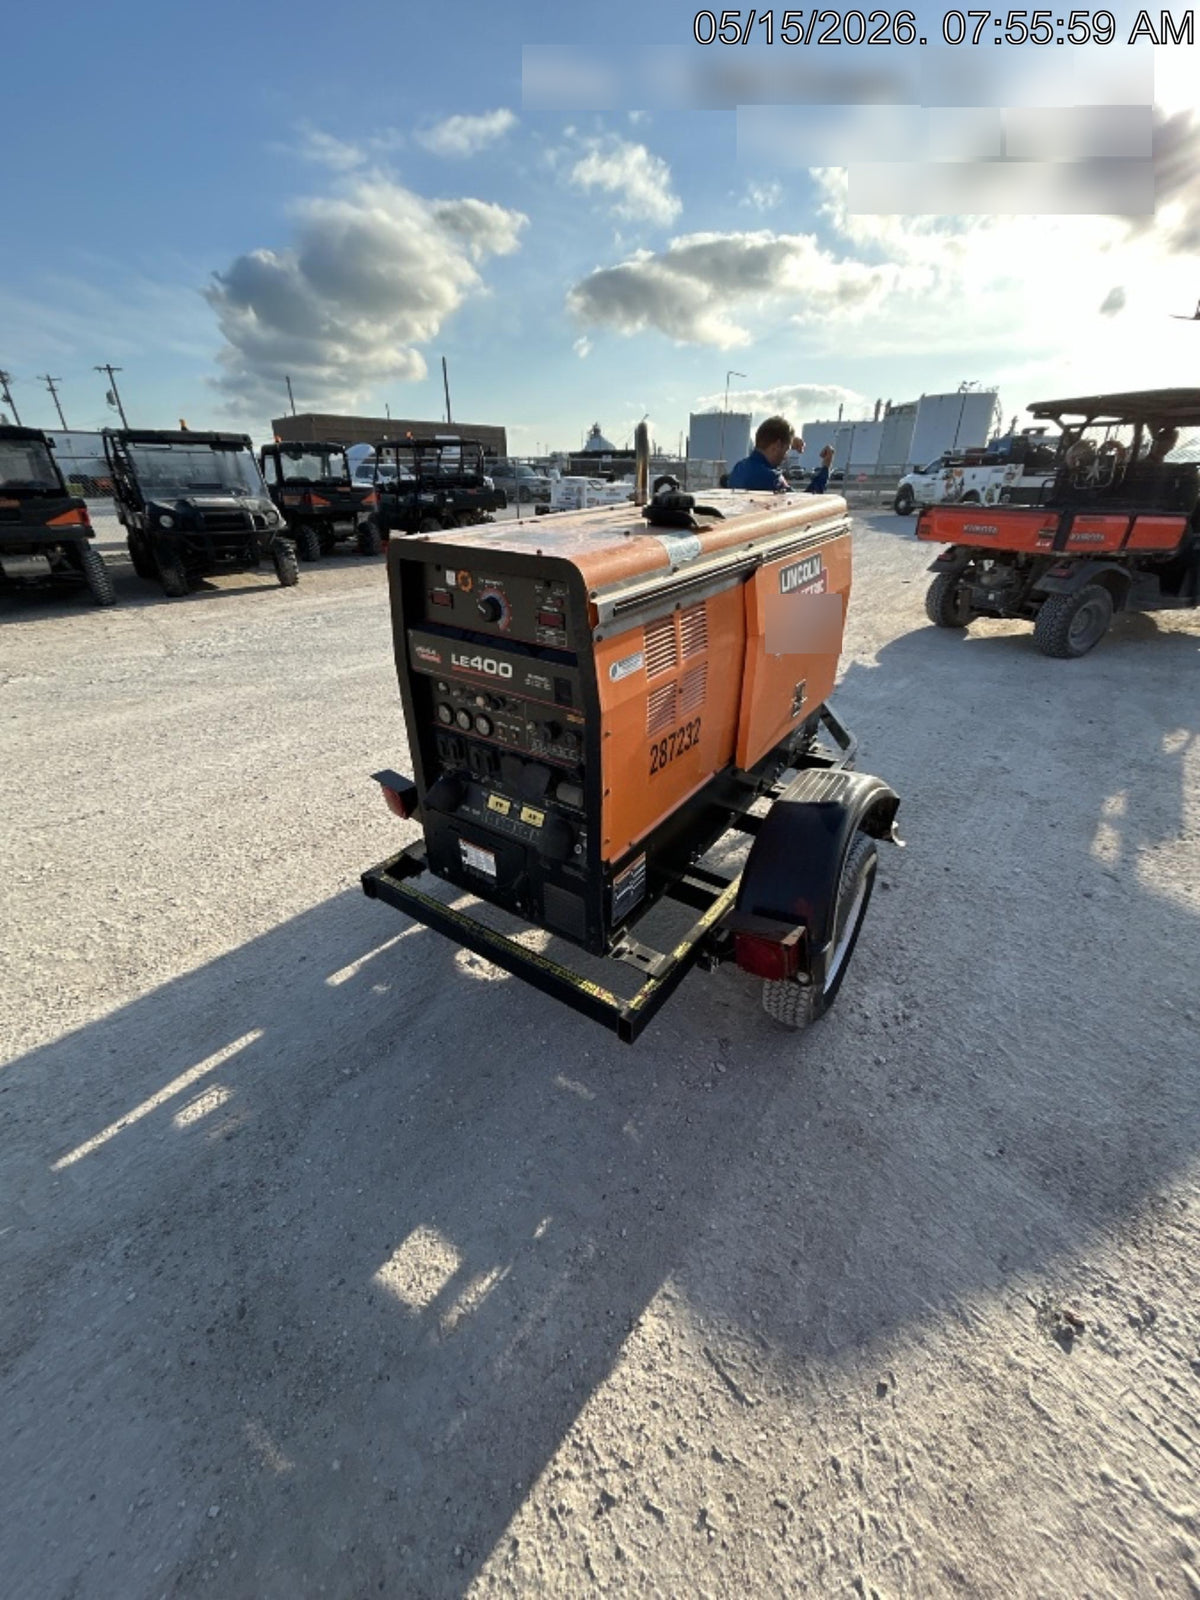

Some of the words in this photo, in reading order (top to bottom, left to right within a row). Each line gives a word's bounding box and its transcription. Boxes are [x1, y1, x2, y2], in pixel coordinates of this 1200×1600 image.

[781, 556, 821, 593] LINCOLN
[451, 653, 513, 678] LE400
[649, 717, 701, 775] 287232
